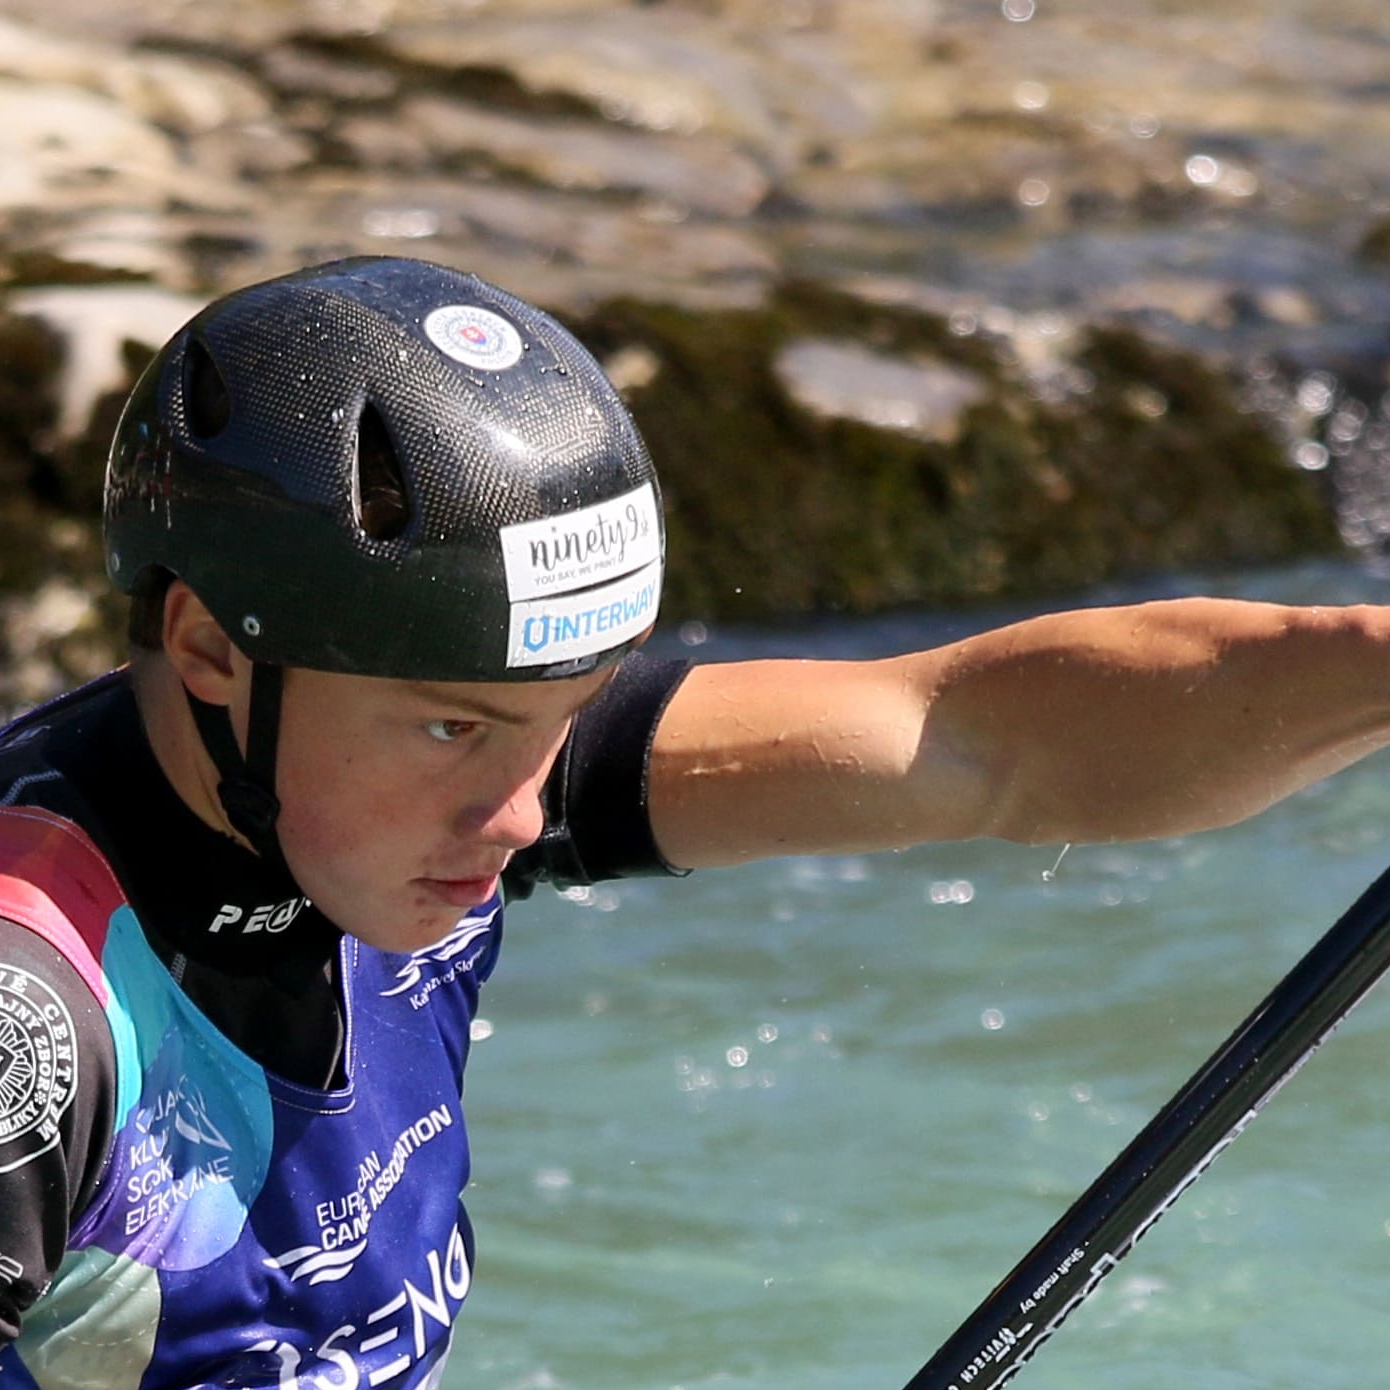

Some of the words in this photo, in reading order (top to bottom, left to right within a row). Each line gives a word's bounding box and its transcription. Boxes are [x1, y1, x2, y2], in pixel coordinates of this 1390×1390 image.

[534, 574, 556, 587] YOU
[552, 578, 656, 643] INTERWAY
[208, 896, 312, 934] PEA
[34, 1034, 52, 1092] ZBOR
